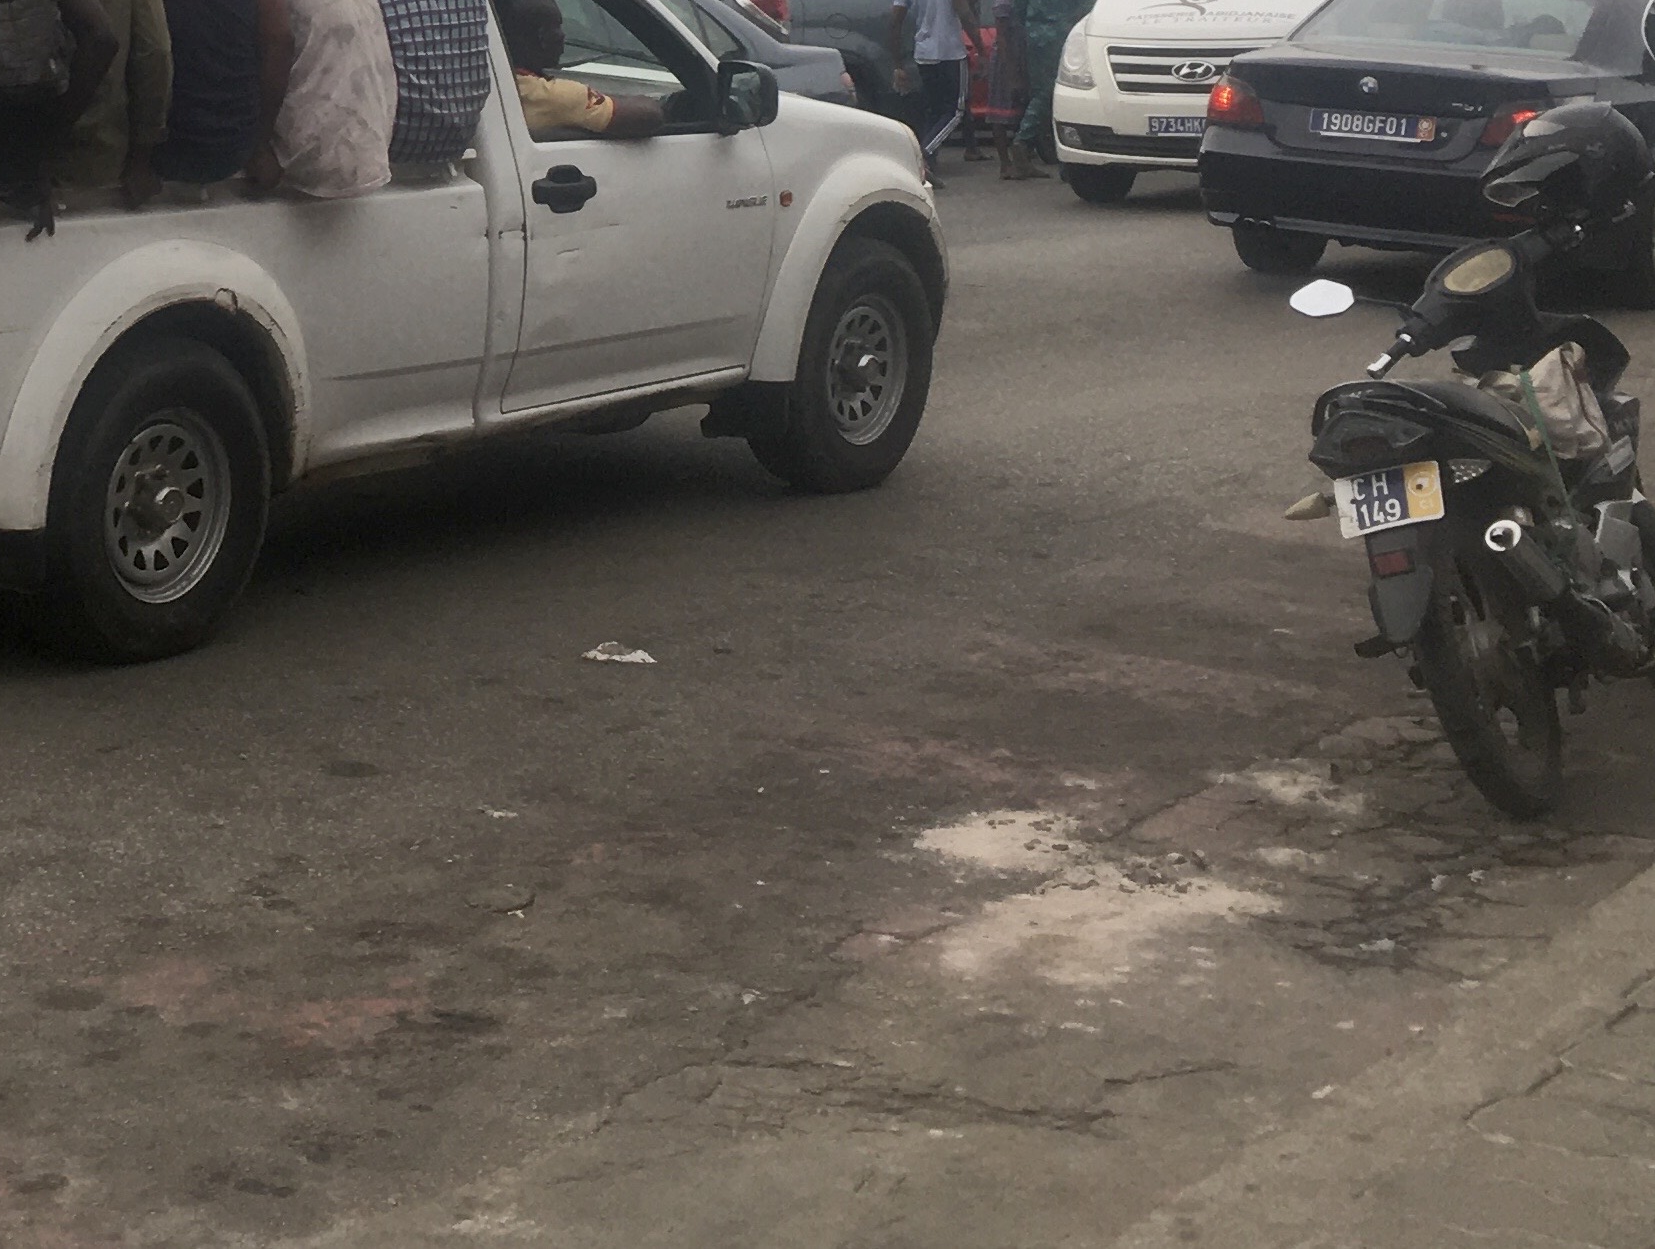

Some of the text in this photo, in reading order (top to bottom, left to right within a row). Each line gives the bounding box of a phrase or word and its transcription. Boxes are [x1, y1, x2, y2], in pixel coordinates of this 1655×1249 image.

[1151, 117, 1206, 133] 9734HK
[1322, 113, 1407, 136] 1908GF01
[1360, 498, 1402, 527] 149
